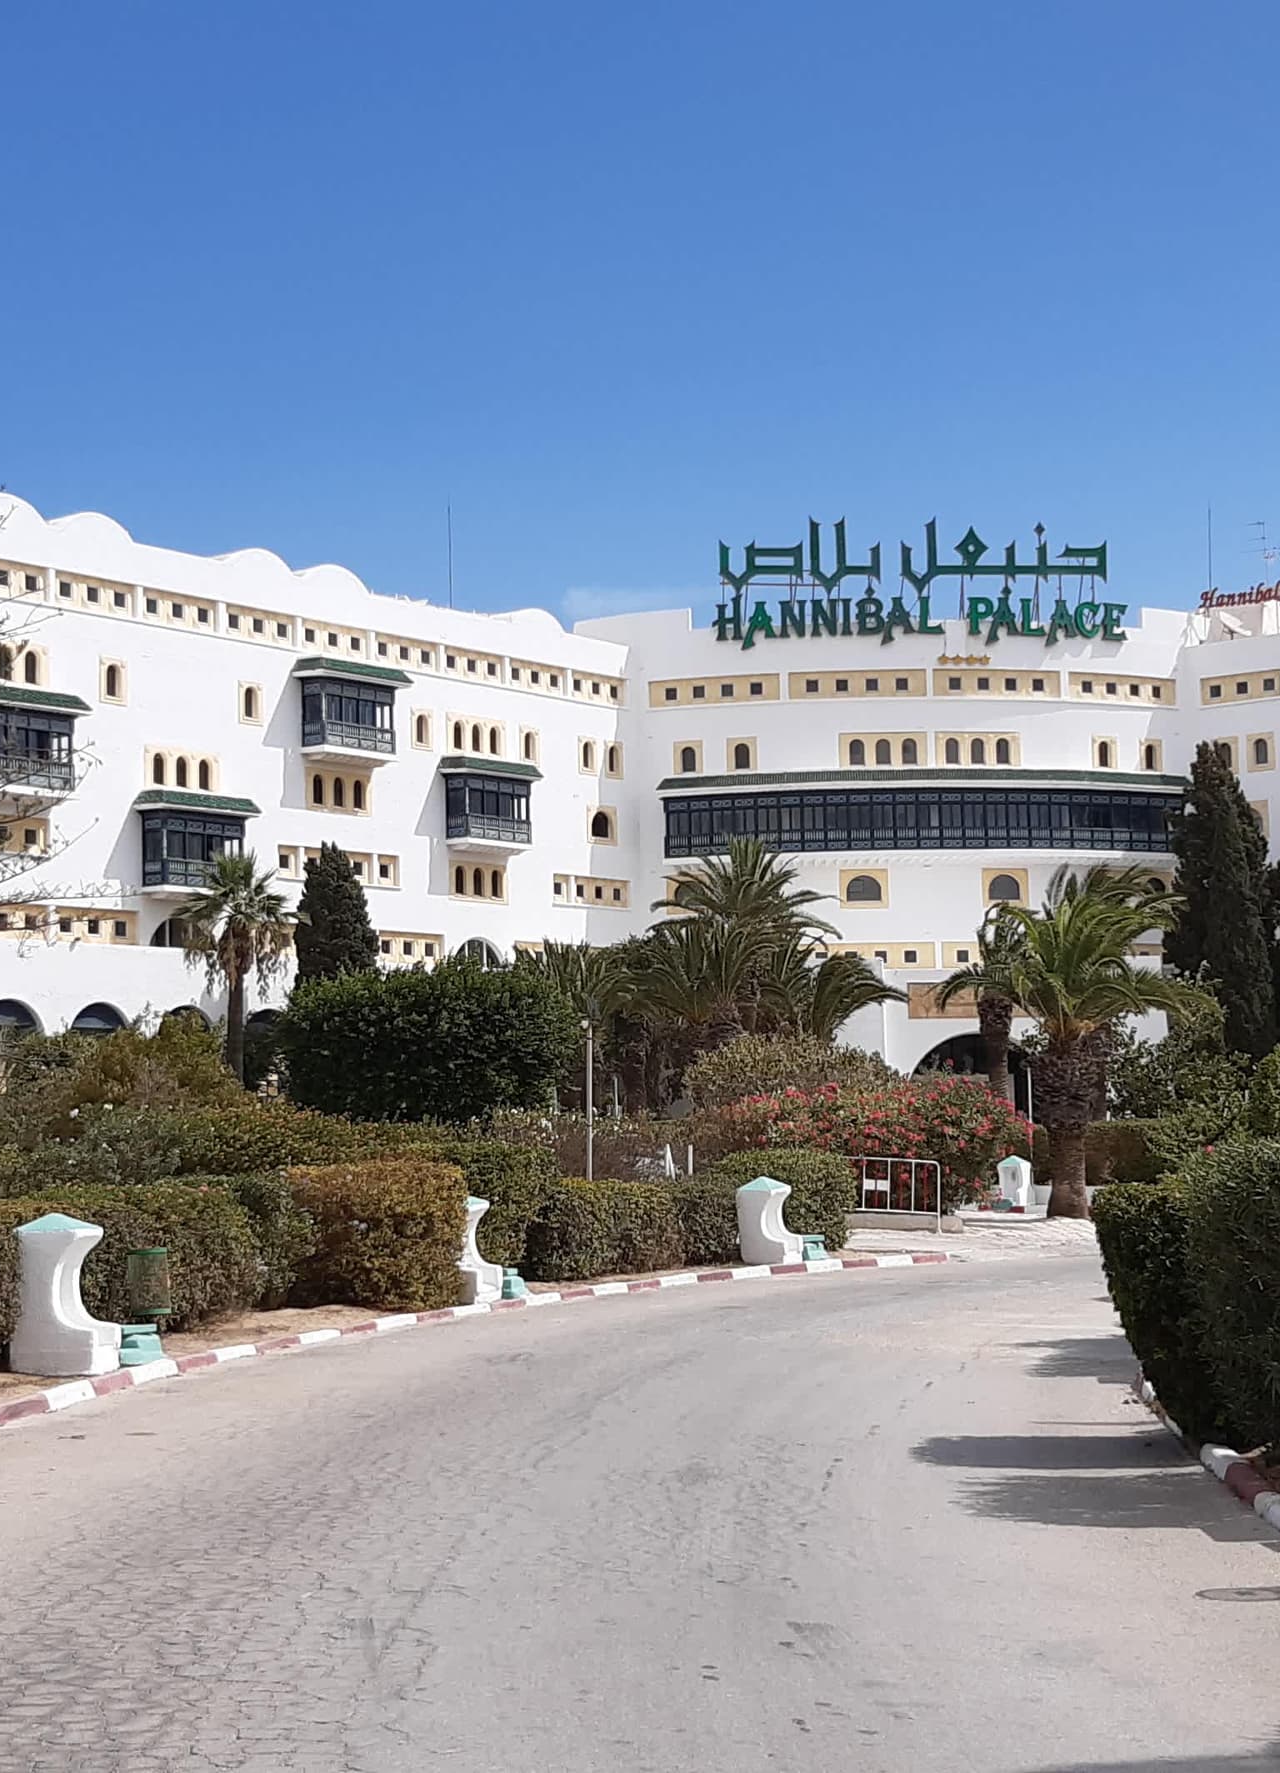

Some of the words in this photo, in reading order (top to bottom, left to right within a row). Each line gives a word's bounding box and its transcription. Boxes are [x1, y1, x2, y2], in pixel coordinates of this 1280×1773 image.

[719, 515, 881, 597] بلاص
[900, 516, 1108, 597] حنبعل
[712, 594, 946, 650] HANNIBAL
[967, 597, 1128, 647] PALACE
